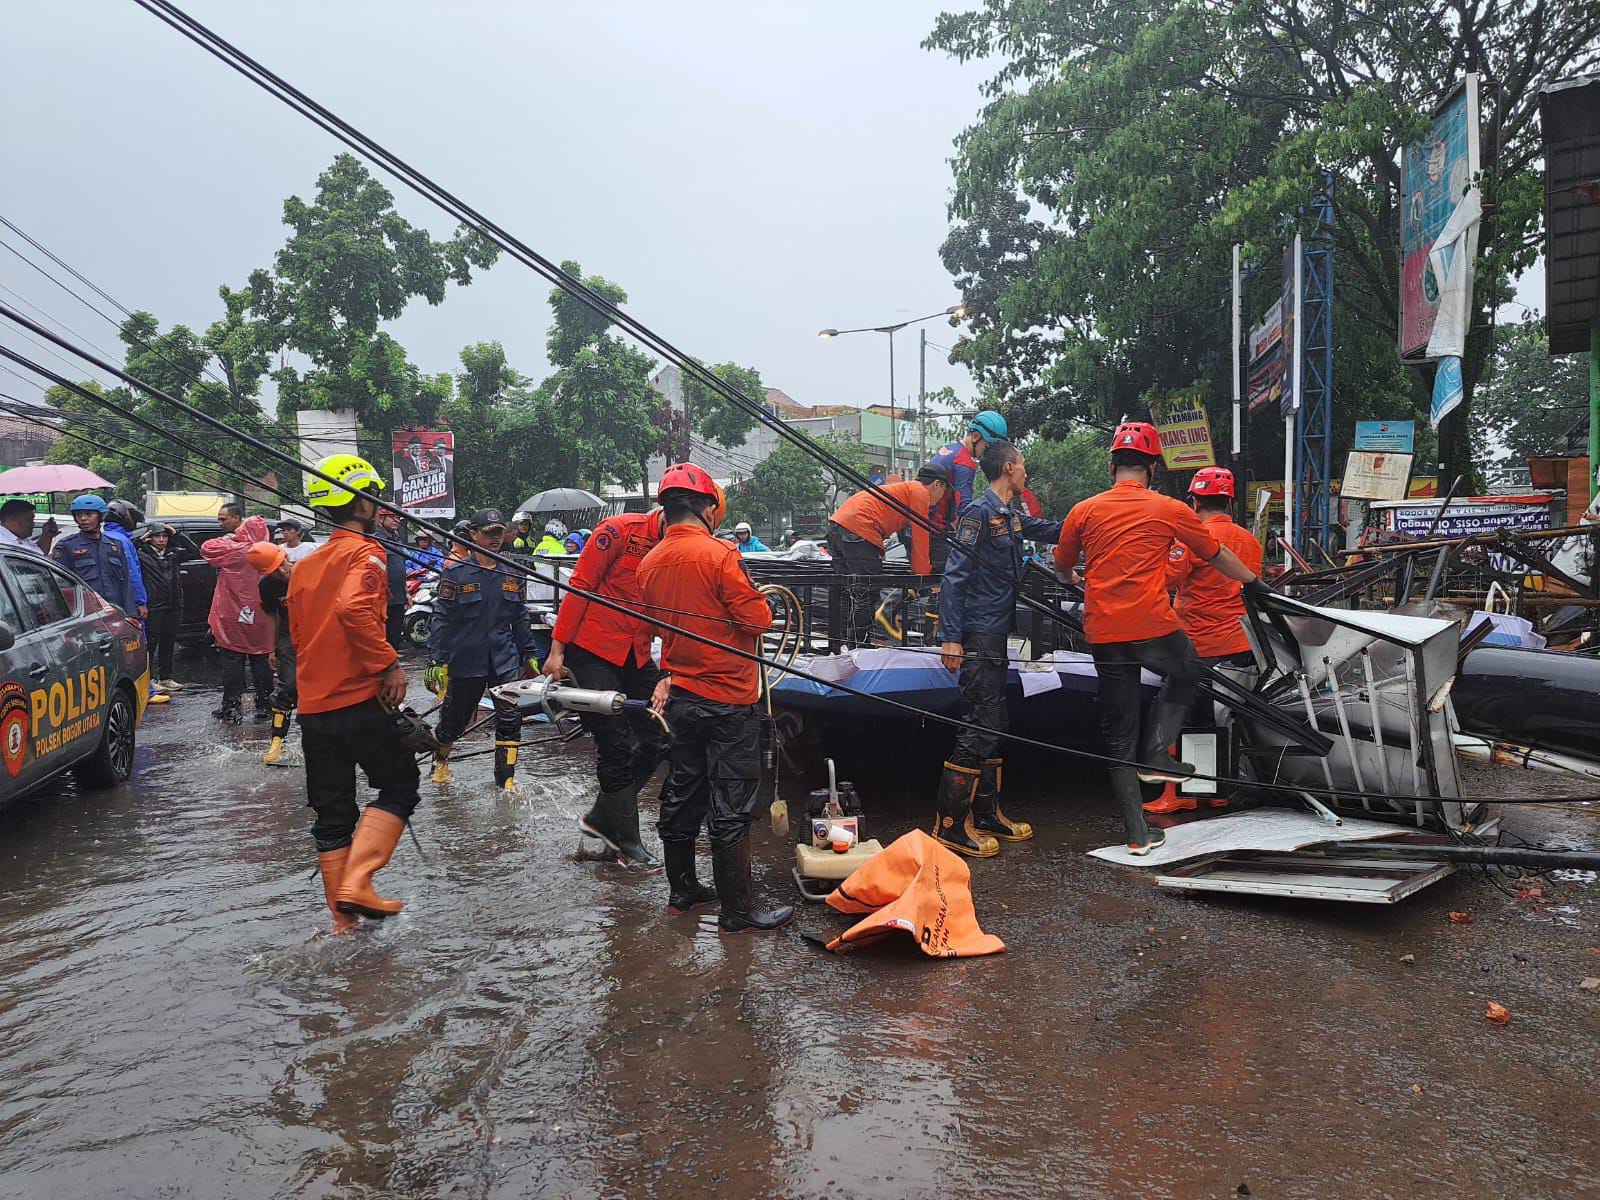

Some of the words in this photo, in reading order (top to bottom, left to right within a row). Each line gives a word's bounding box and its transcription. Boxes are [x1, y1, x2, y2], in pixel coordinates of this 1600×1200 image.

[402, 471, 446, 492] GANJAR
[402, 483, 446, 503] MAHFUD
[1398, 520, 1449, 529] Olhraga)
[1453, 518, 1480, 528] OSIS,
[1484, 516, 1515, 525] Ketua
[31, 665, 106, 738] POLISI
[36, 731, 61, 758] POLSEK
[62, 721, 82, 742] BOGOR
[82, 712, 100, 735] UTARA
